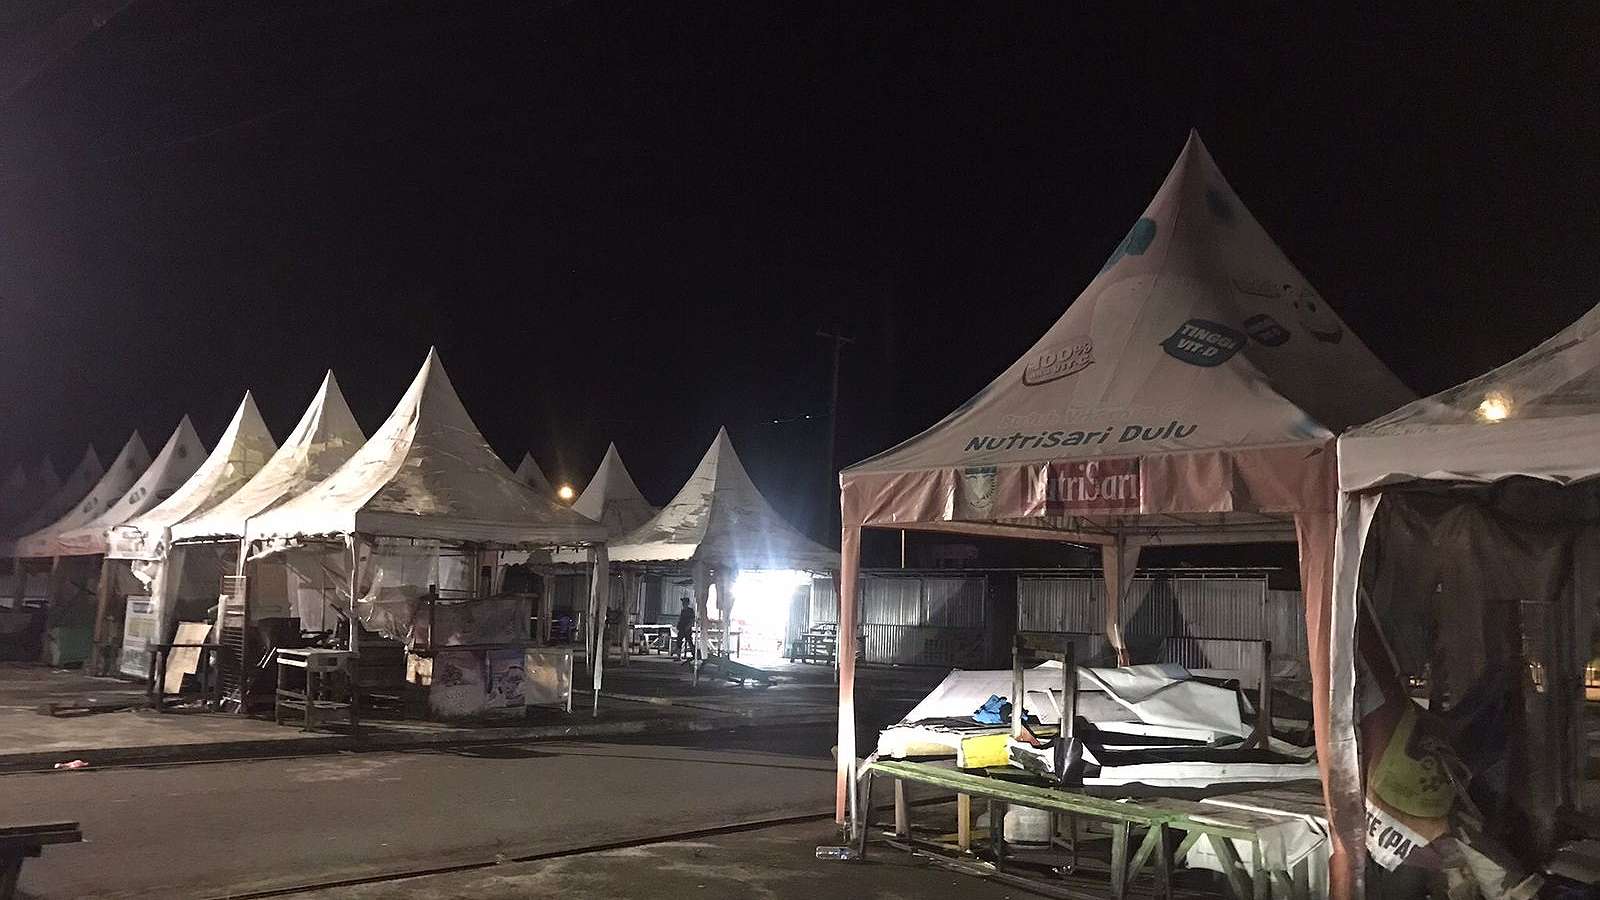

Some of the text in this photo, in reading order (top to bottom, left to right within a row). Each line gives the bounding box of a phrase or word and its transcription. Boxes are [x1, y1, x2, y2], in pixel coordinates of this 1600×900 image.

[963, 420, 1198, 452] NutriSari Dulu
[1378, 826, 1418, 860] (PA
